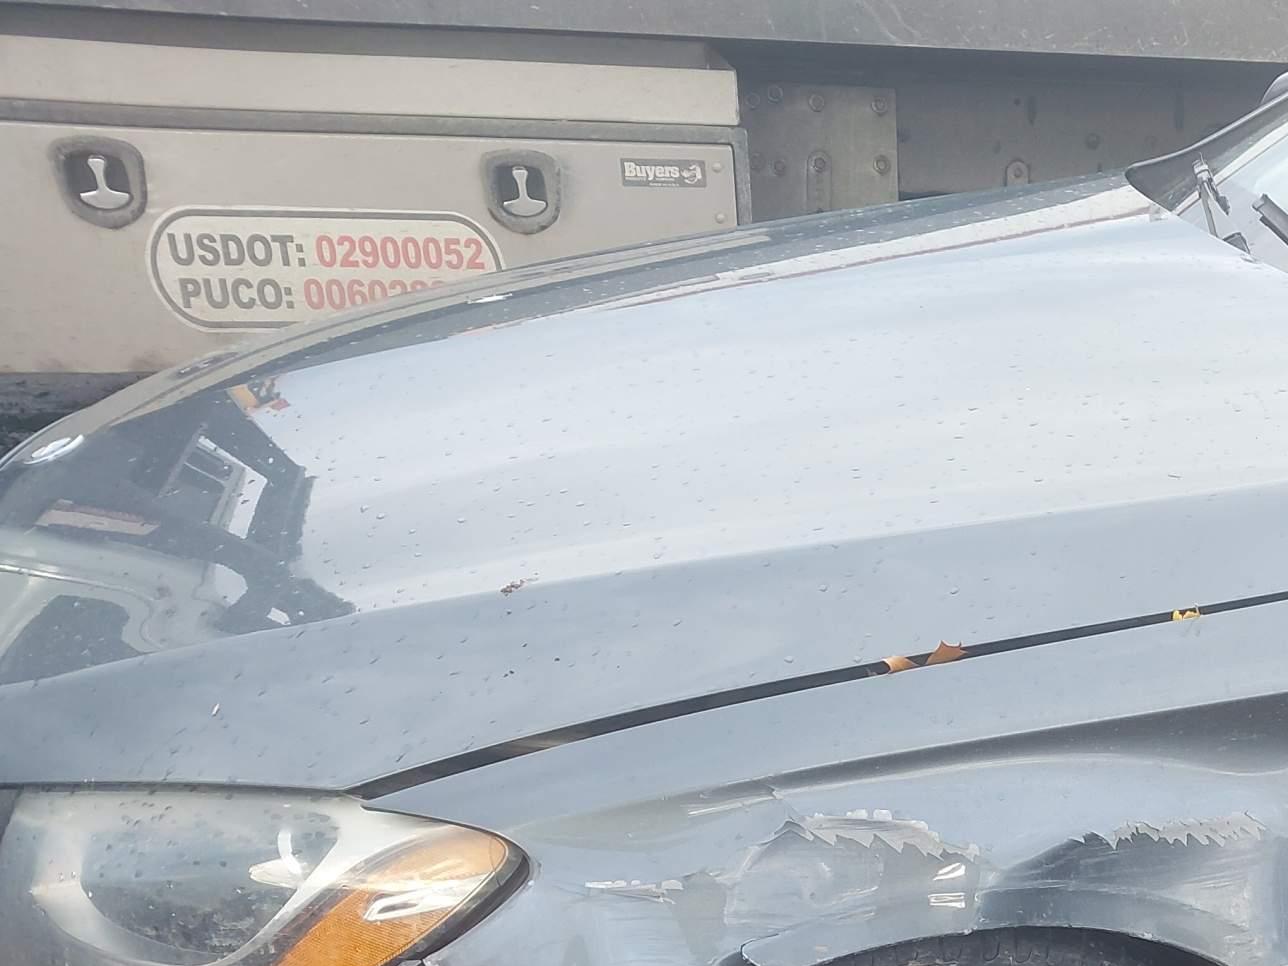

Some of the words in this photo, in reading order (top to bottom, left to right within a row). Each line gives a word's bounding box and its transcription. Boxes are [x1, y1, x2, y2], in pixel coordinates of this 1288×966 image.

[623, 161, 681, 181] Buyers
[167, 232, 307, 268] USDOT:
[315, 234, 486, 271] 02900052
[178, 277, 296, 310] PUCO:
